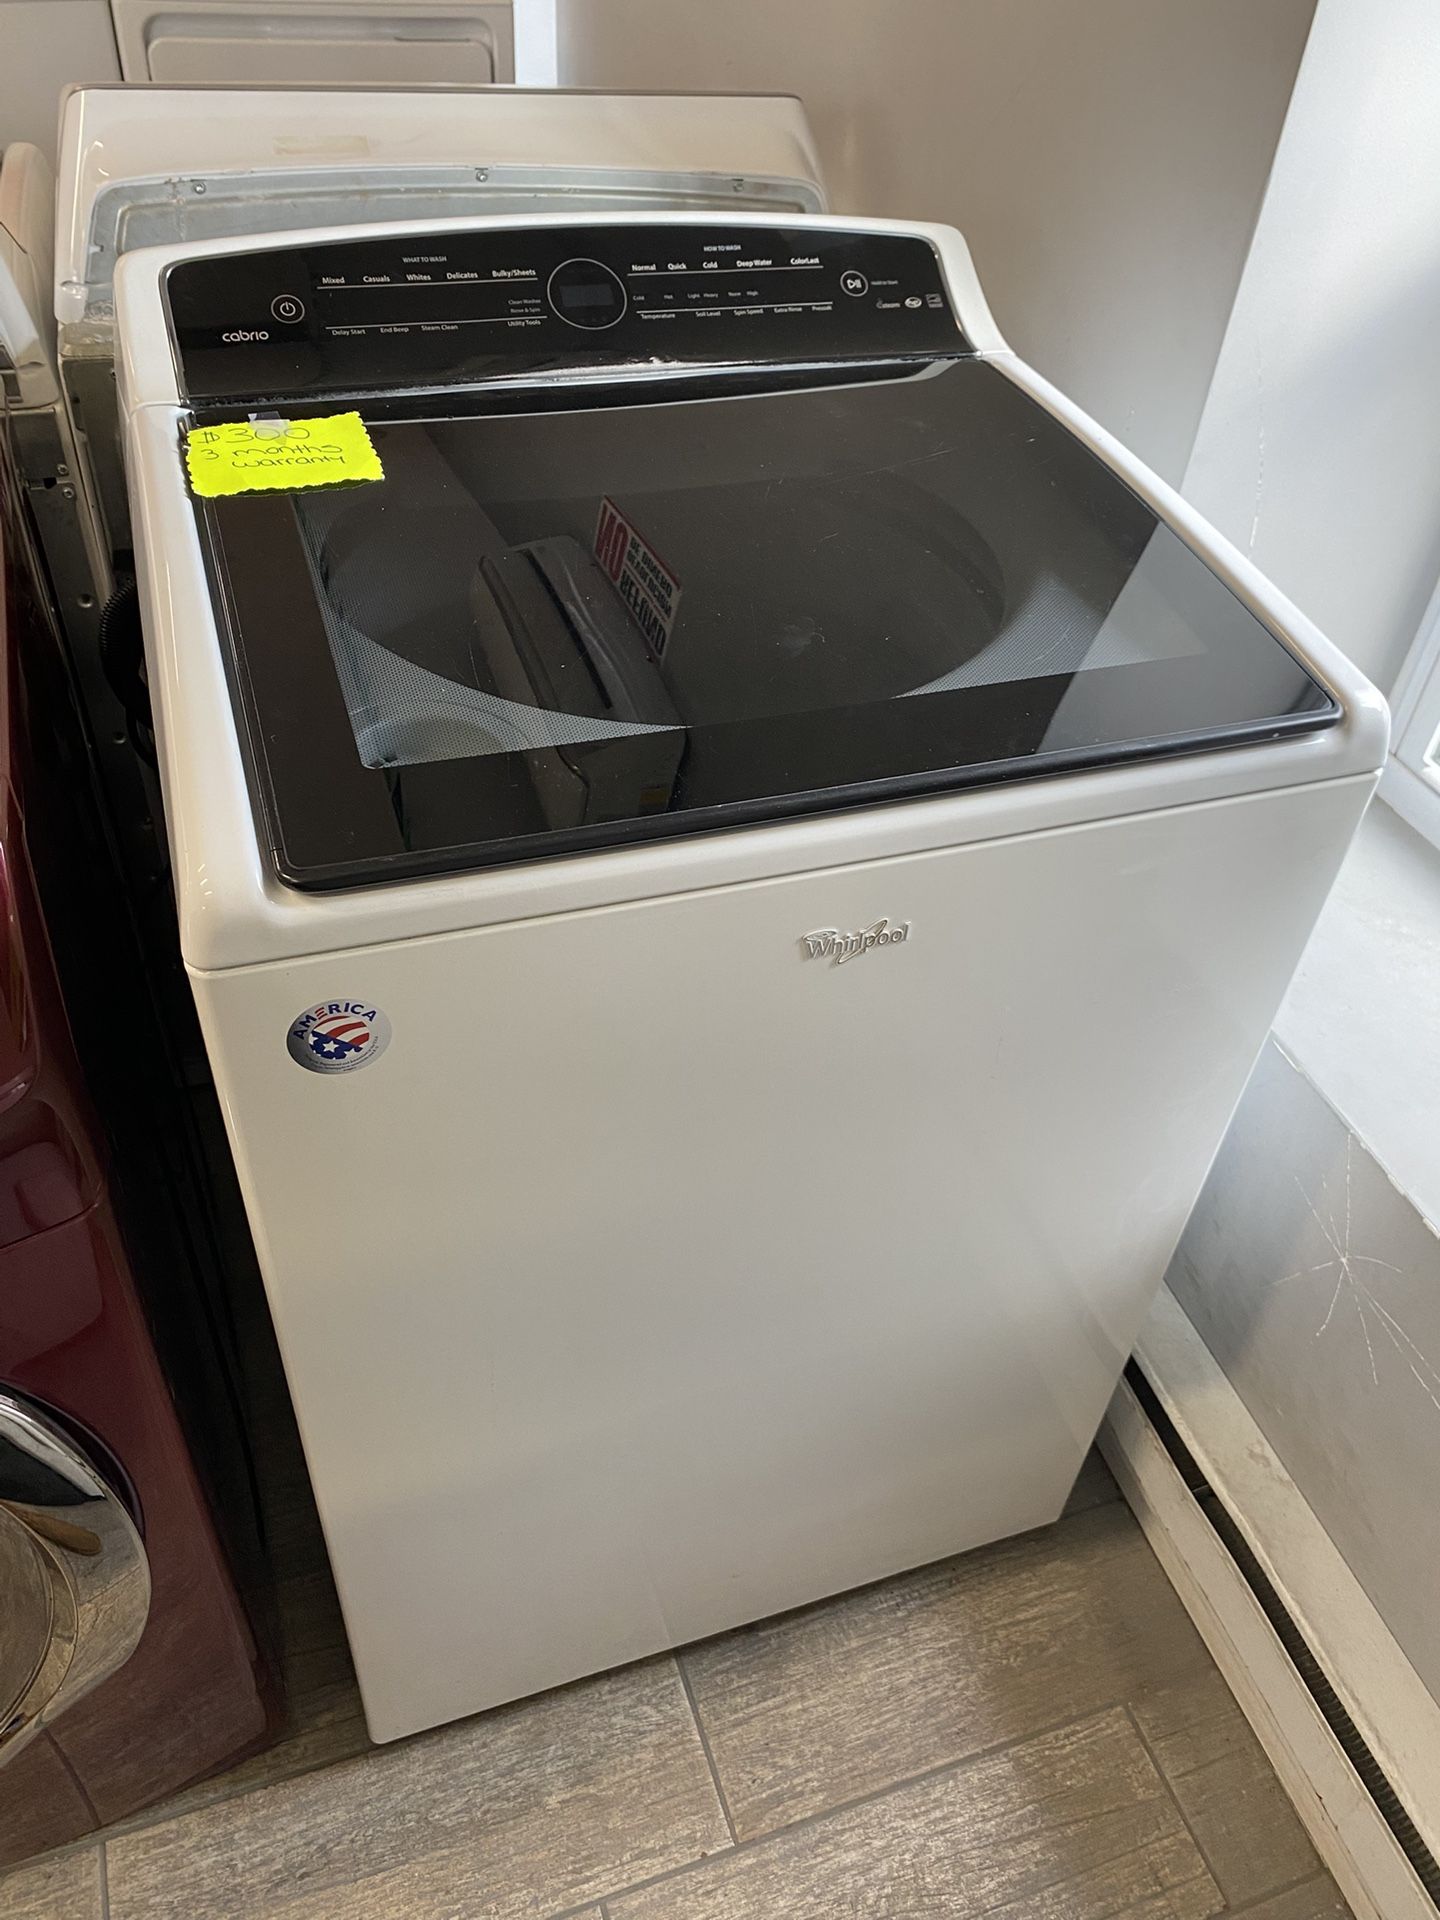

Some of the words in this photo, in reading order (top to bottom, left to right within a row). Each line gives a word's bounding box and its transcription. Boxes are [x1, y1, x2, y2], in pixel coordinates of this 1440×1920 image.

[668, 263, 687, 271] Quick
[703, 261, 718, 269] Cold
[736, 260, 753, 269] Deep
[753, 259, 772, 267] Water
[790, 257, 820, 265] ColorLast
[322, 277, 345, 285] Mixed
[363, 275, 390, 283] Casuals
[406, 273, 431, 281] Whites
[447, 272, 478, 280] Delicates
[492, 269, 536, 278] Bulky/Sheets
[734, 309, 747, 317] Spin
[747, 308, 764, 316] Speed
[525, 319, 541, 327] Tools
[221, 330, 269, 343] cabrio
[332, 329, 349, 337] Delay
[392, 326, 409, 334] Beep
[197, 427, 310, 444] $300
[201, 449, 219, 460] 3
[232, 445, 342, 457] months
[231, 455, 345, 468] warranty
[803, 918, 911, 964] Whirlpool
[293, 1002, 377, 1040] AMERICA
